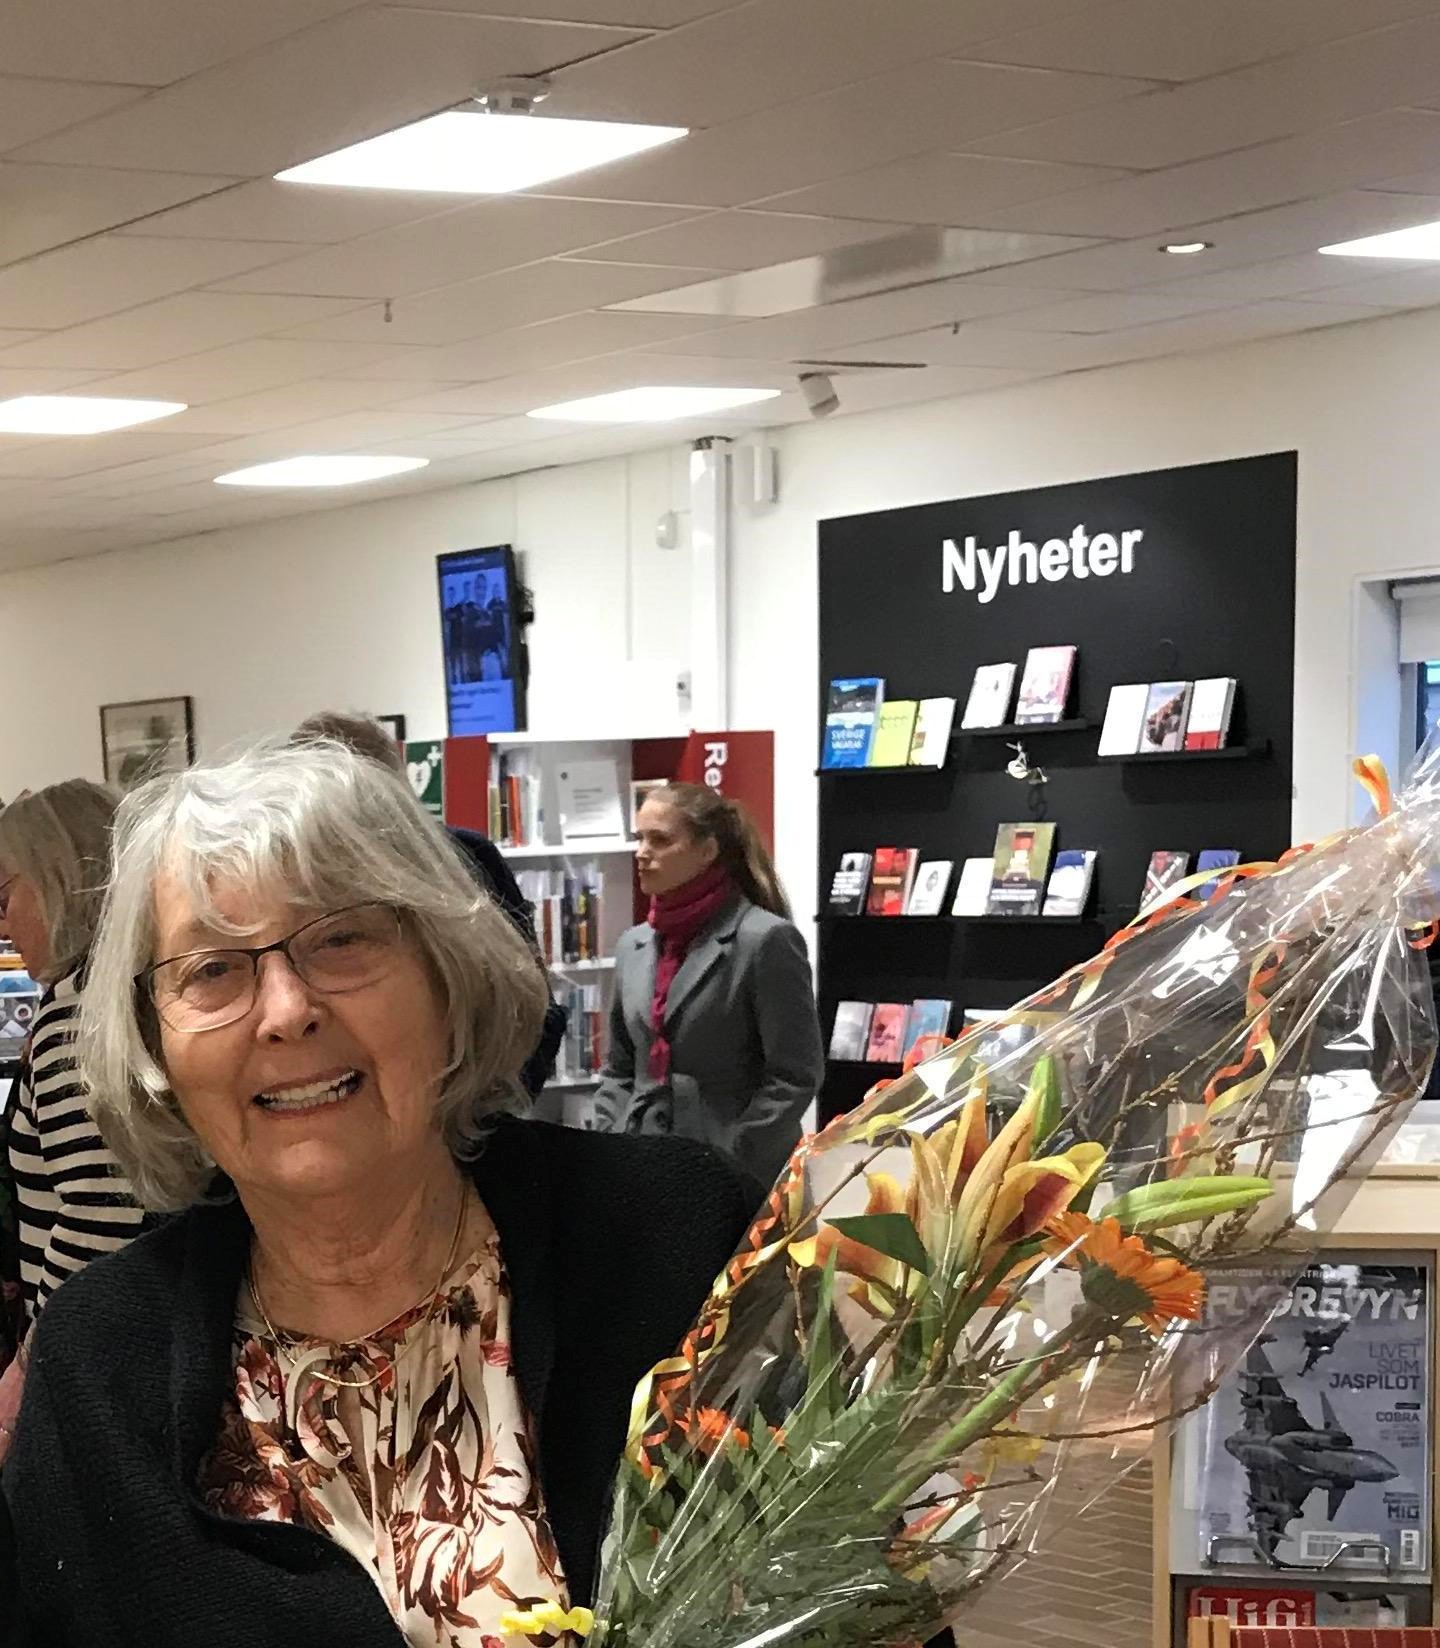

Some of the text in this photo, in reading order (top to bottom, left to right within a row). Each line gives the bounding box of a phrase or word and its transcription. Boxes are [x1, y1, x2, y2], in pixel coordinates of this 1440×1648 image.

[942, 524, 1143, 604] Nyheter
[703, 741, 728, 796] Re
[1369, 1342, 1421, 1358] LIVET
[1377, 1358, 1420, 1374] SOM
[1329, 1373, 1421, 1390] JASPILOT
[1376, 1411, 1421, 1423] COBRA
